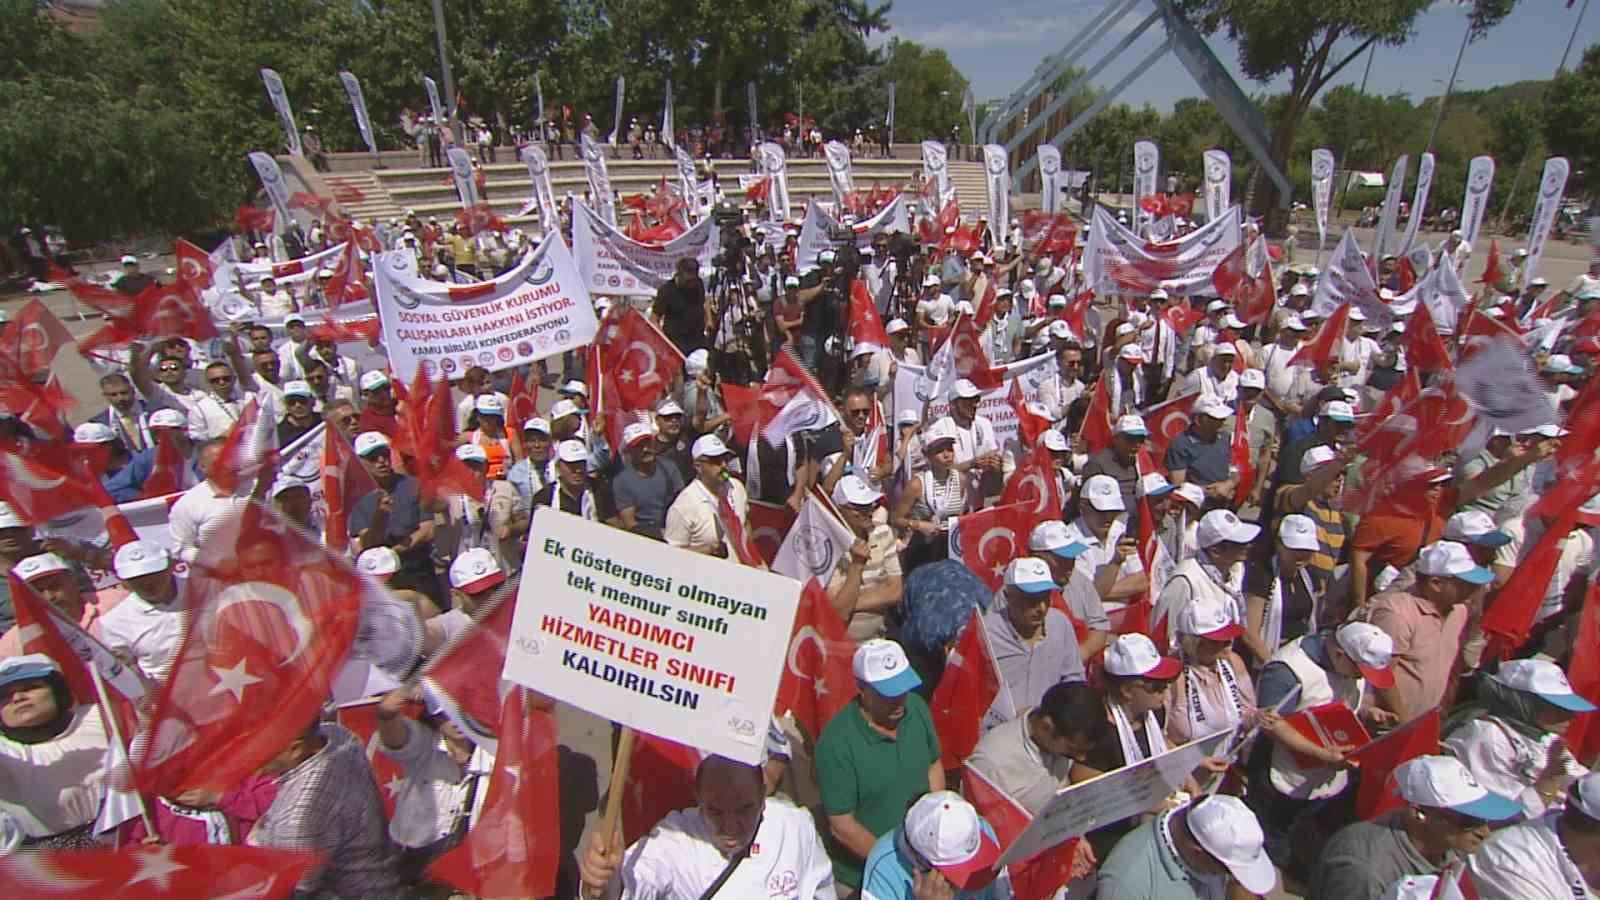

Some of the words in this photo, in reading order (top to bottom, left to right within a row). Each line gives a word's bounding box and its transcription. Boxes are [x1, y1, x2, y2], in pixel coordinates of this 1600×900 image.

[396, 325, 472, 343] ÇALIŞANLARI
[474, 313, 525, 335] HAKKINI
[526, 297, 576, 321] İSTİYOR.
[398, 310, 440, 324] SOSYAL
[442, 300, 504, 322] GÜVENLİK
[505, 281, 561, 312] KURUMU
[411, 344, 442, 356] KAMU
[444, 339, 478, 354] BİRLİĞİ
[479, 316, 569, 349] KONFEDERASYONU
[543, 537, 565, 559] Ek
[570, 547, 671, 593] Göstergesi
[678, 584, 768, 621] olmayan
[566, 570, 596, 593] tek
[601, 586, 671, 617] memur
[676, 610, 729, 635] sınıfı
[541, 614, 658, 671] HİZMETLER
[666, 658, 736, 694] SINIFI
[587, 602, 695, 653] YARDIMCI
[562, 650, 700, 711] KALDIRILSIN
